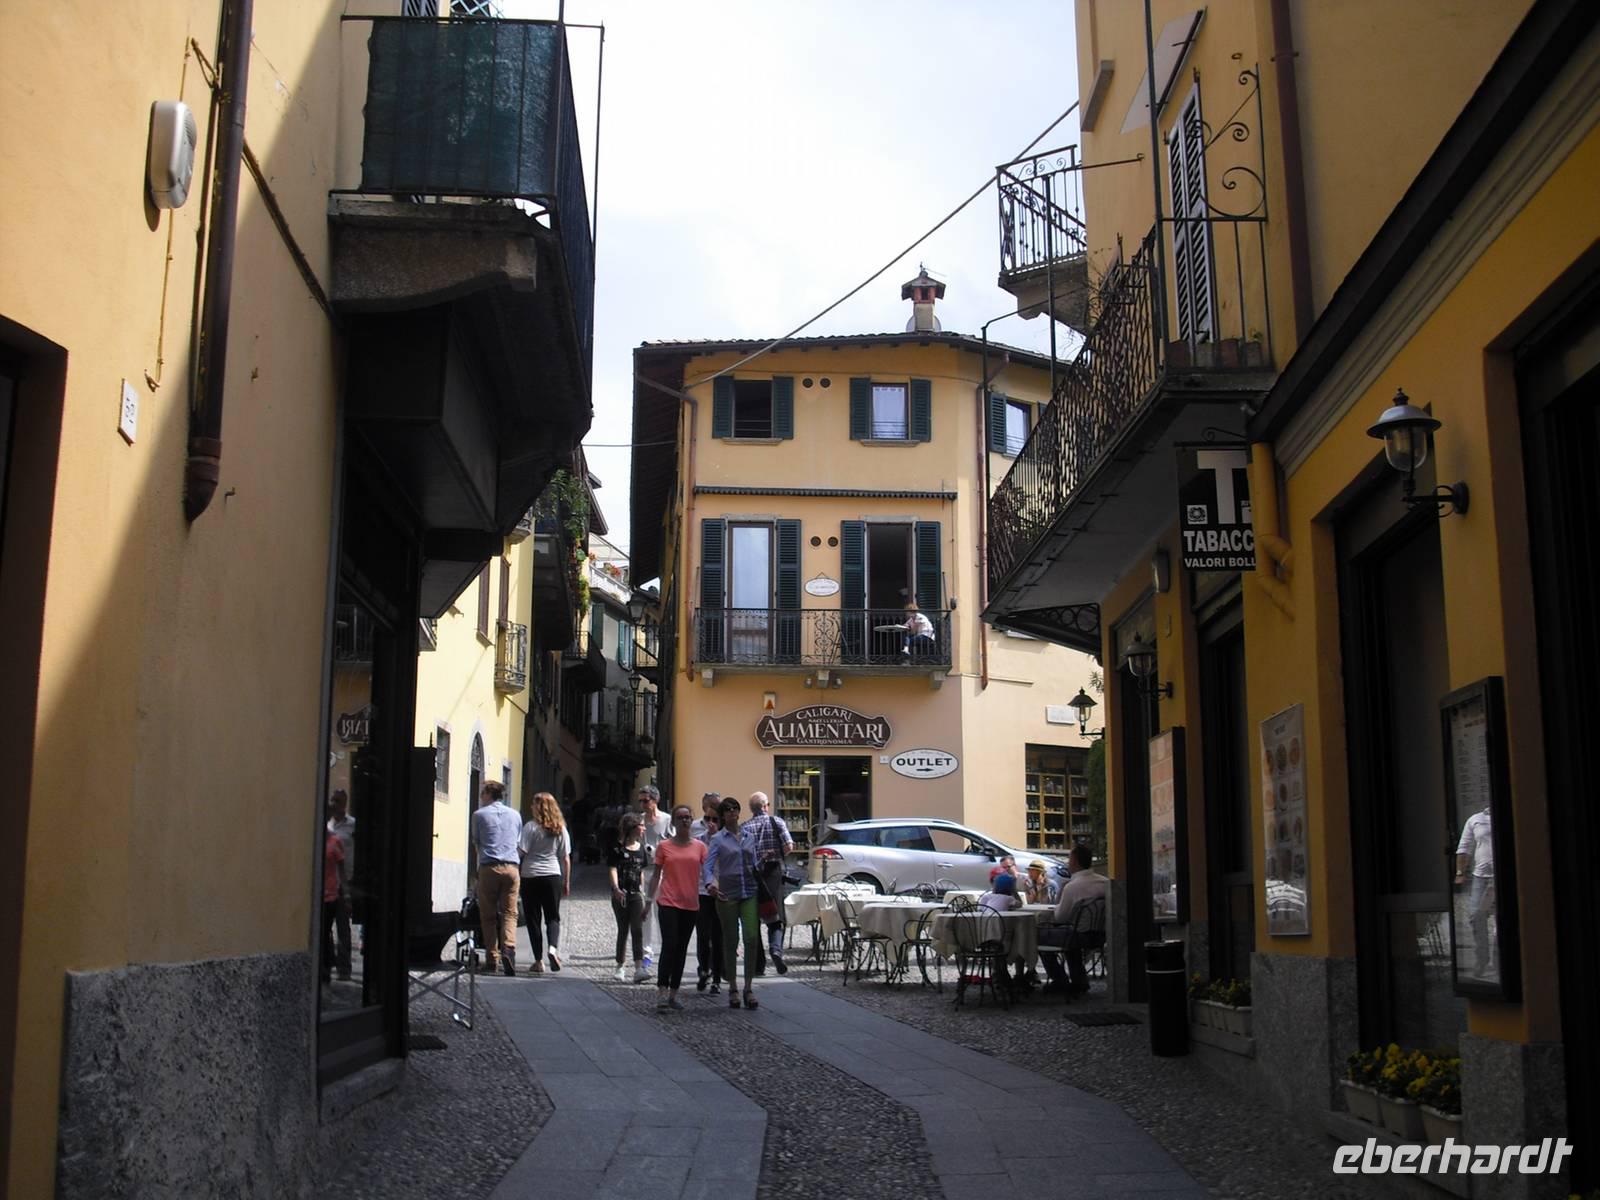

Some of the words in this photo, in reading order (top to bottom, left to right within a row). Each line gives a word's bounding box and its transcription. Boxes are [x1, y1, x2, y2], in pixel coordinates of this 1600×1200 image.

[1197, 450, 1247, 524] T
[1184, 557, 1226, 568] VALORI
[796, 707, 852, 722] CALIGARI
[762, 719, 883, 743] ALIMENTARI
[896, 758, 953, 766] OUTLET
